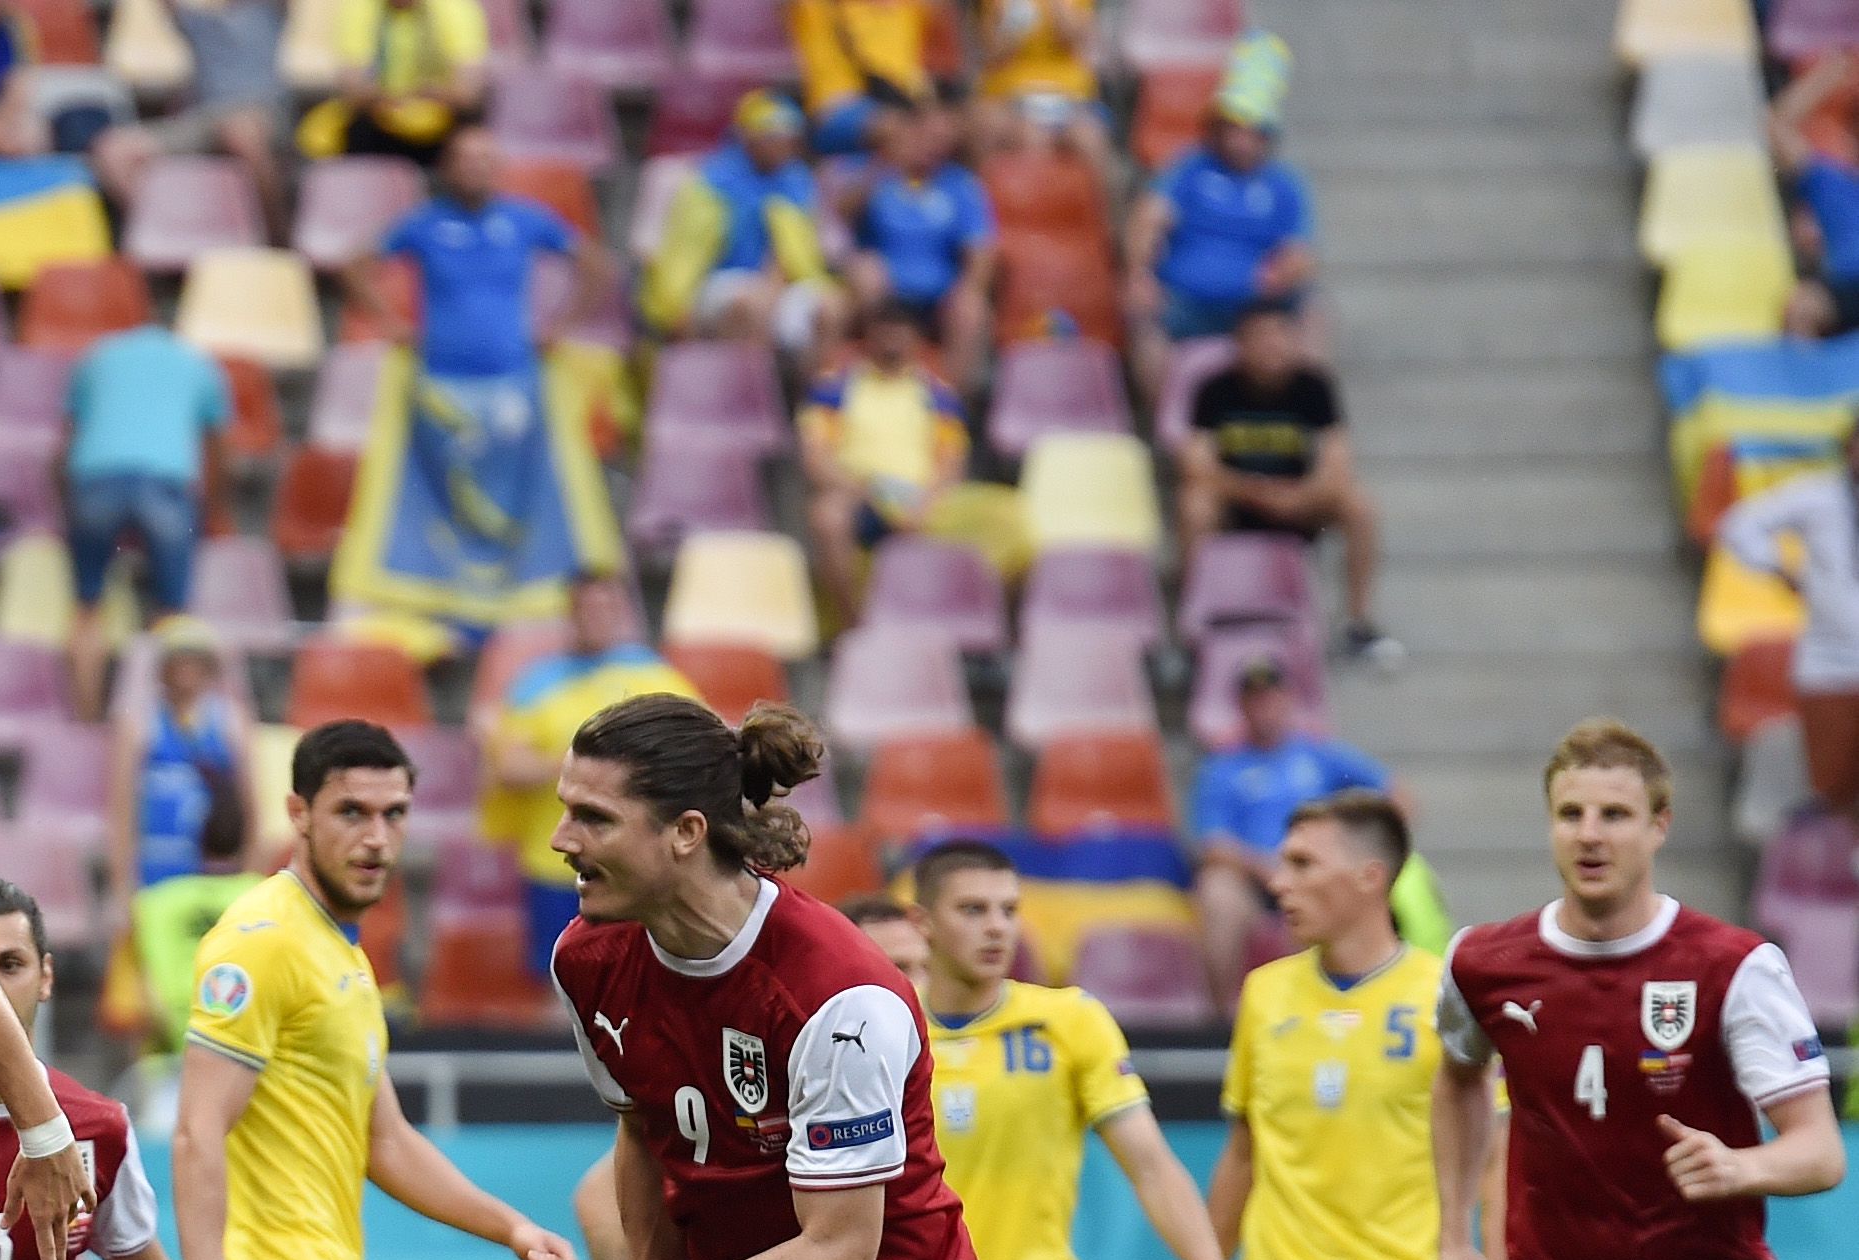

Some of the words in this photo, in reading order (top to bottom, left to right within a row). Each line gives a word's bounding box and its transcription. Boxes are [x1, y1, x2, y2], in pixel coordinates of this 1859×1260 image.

[1001, 1025, 1054, 1074] 16
[1384, 1007, 1417, 1060] 5
[1573, 1044, 1609, 1119] 4
[674, 1085, 710, 1165] 9
[833, 1118, 893, 1141] RESPECT
